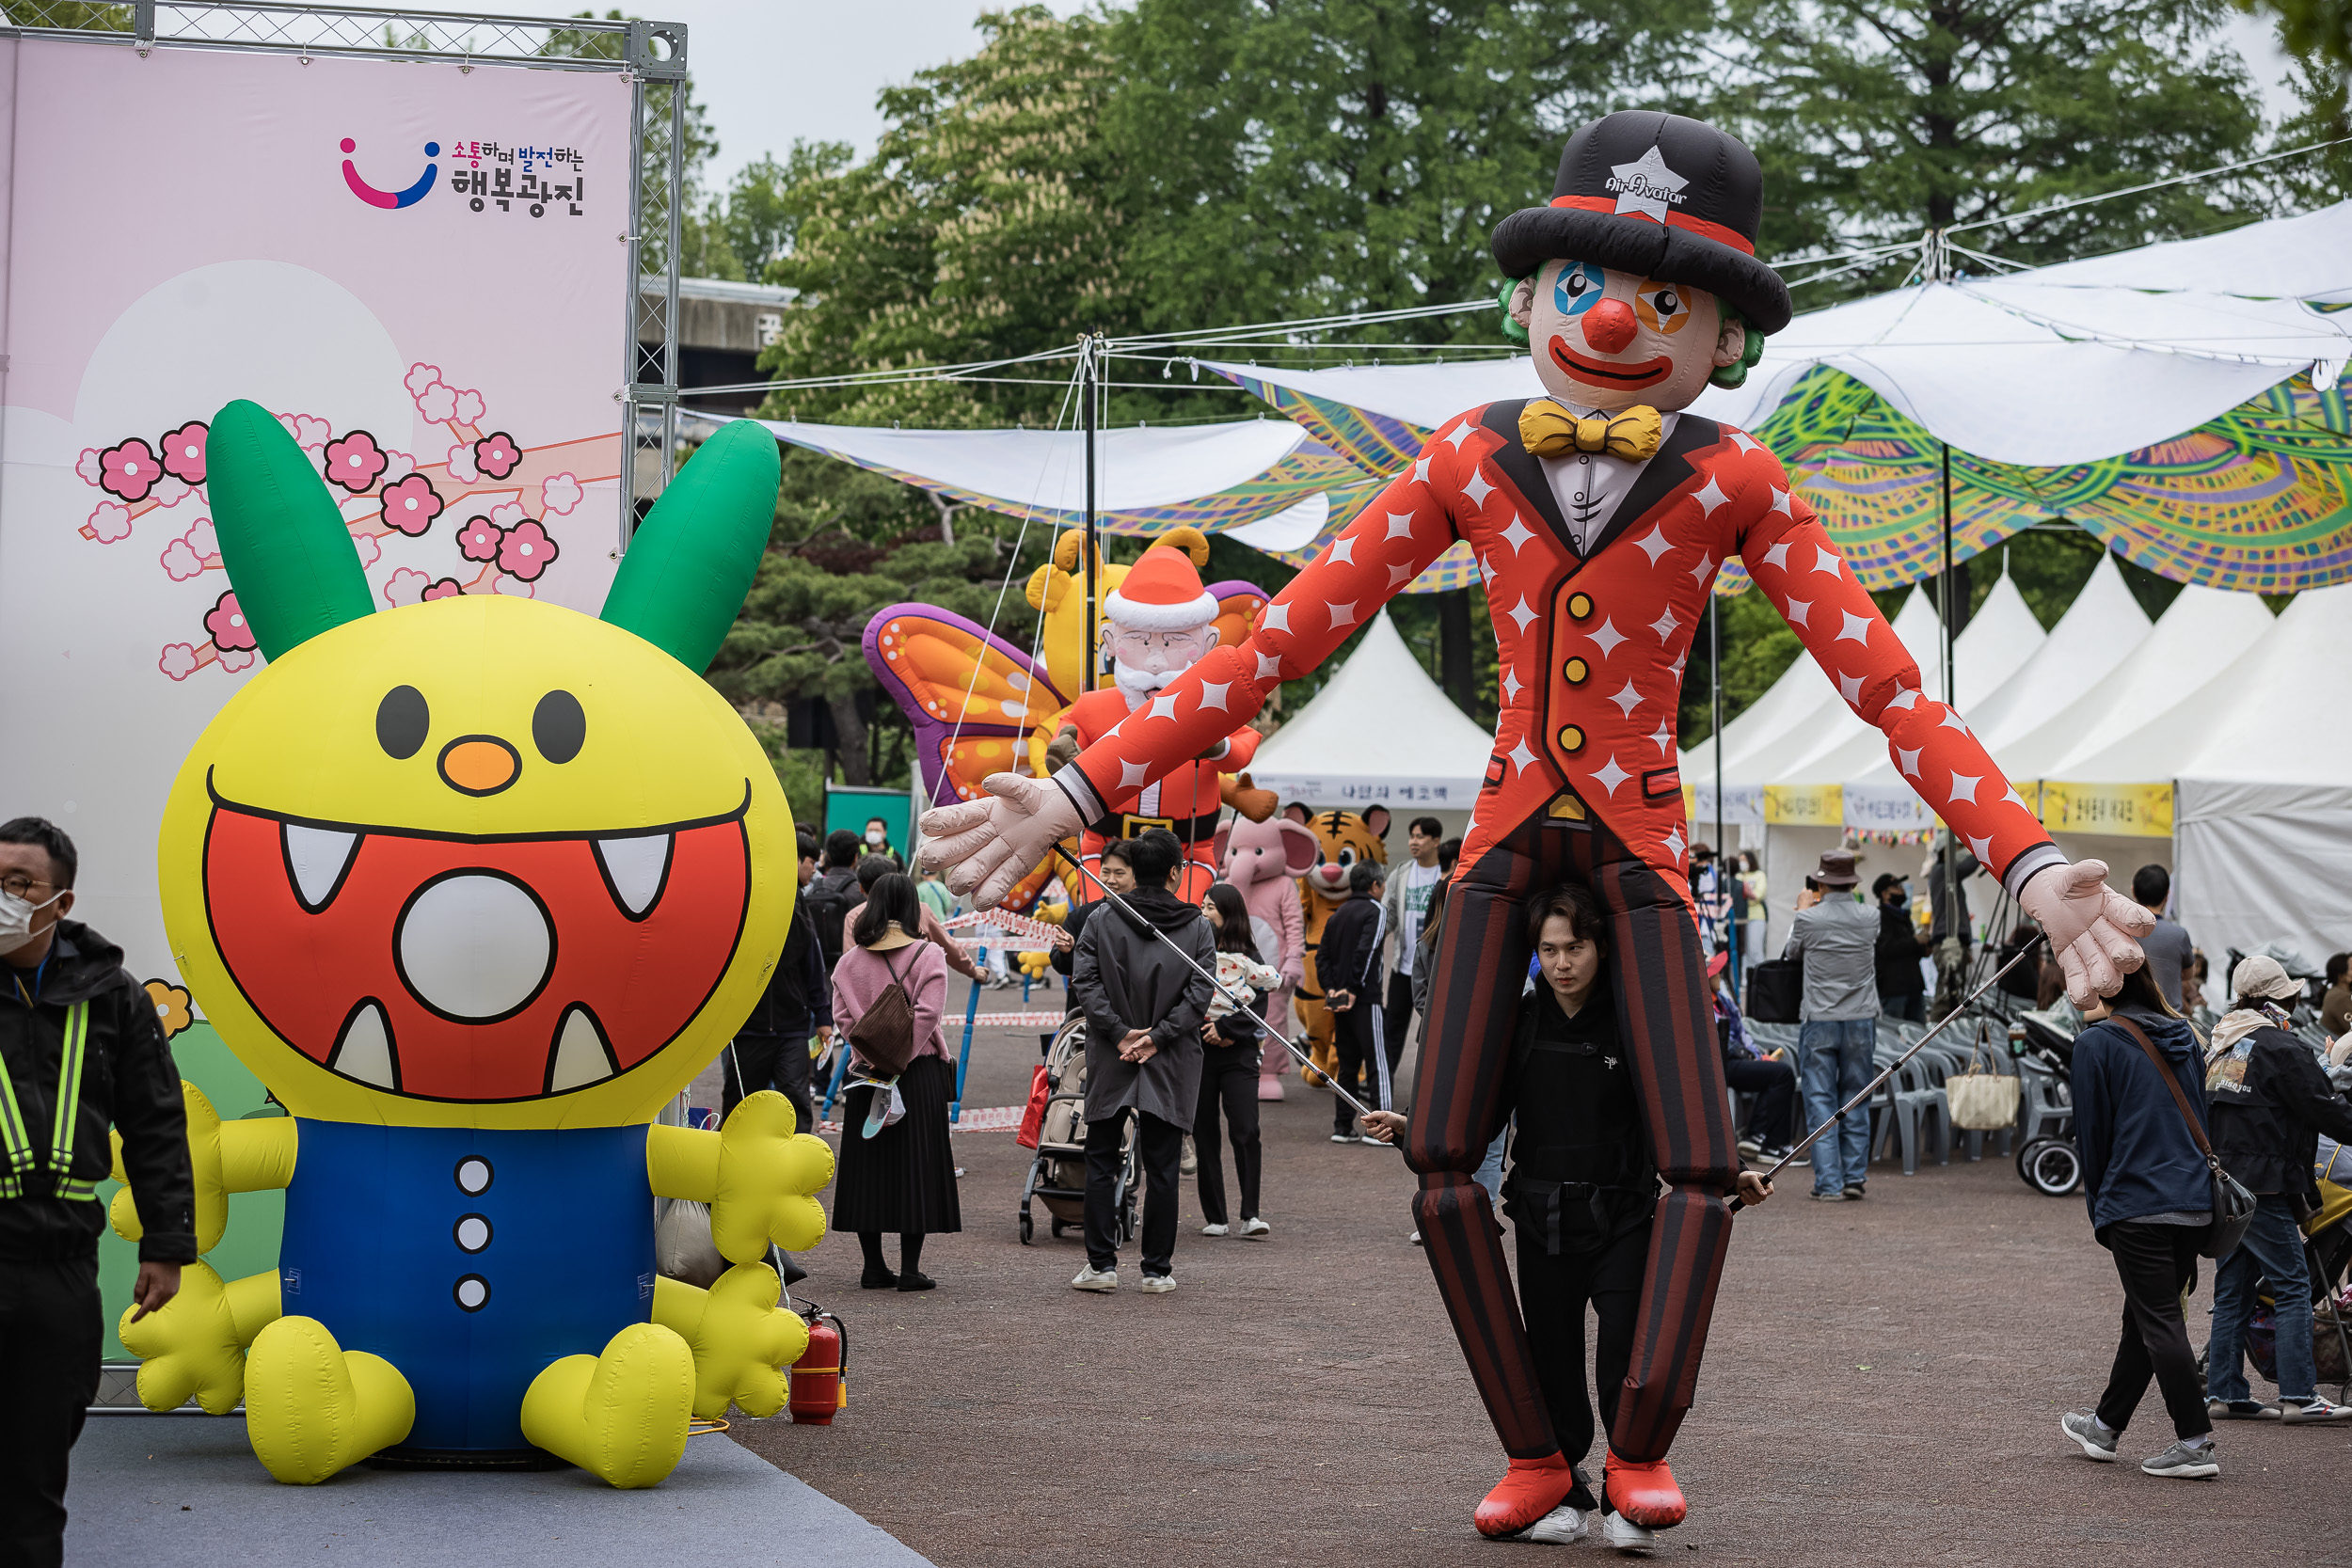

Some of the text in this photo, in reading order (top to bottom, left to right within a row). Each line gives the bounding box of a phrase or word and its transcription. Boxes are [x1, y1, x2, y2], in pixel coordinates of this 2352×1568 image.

[452, 141, 584, 172] 소통하며 발전하는
[452, 167, 583, 218] 행복광진
[1605, 173, 1687, 204] AirAvatar
[2238, 1085, 2251, 1093] you
